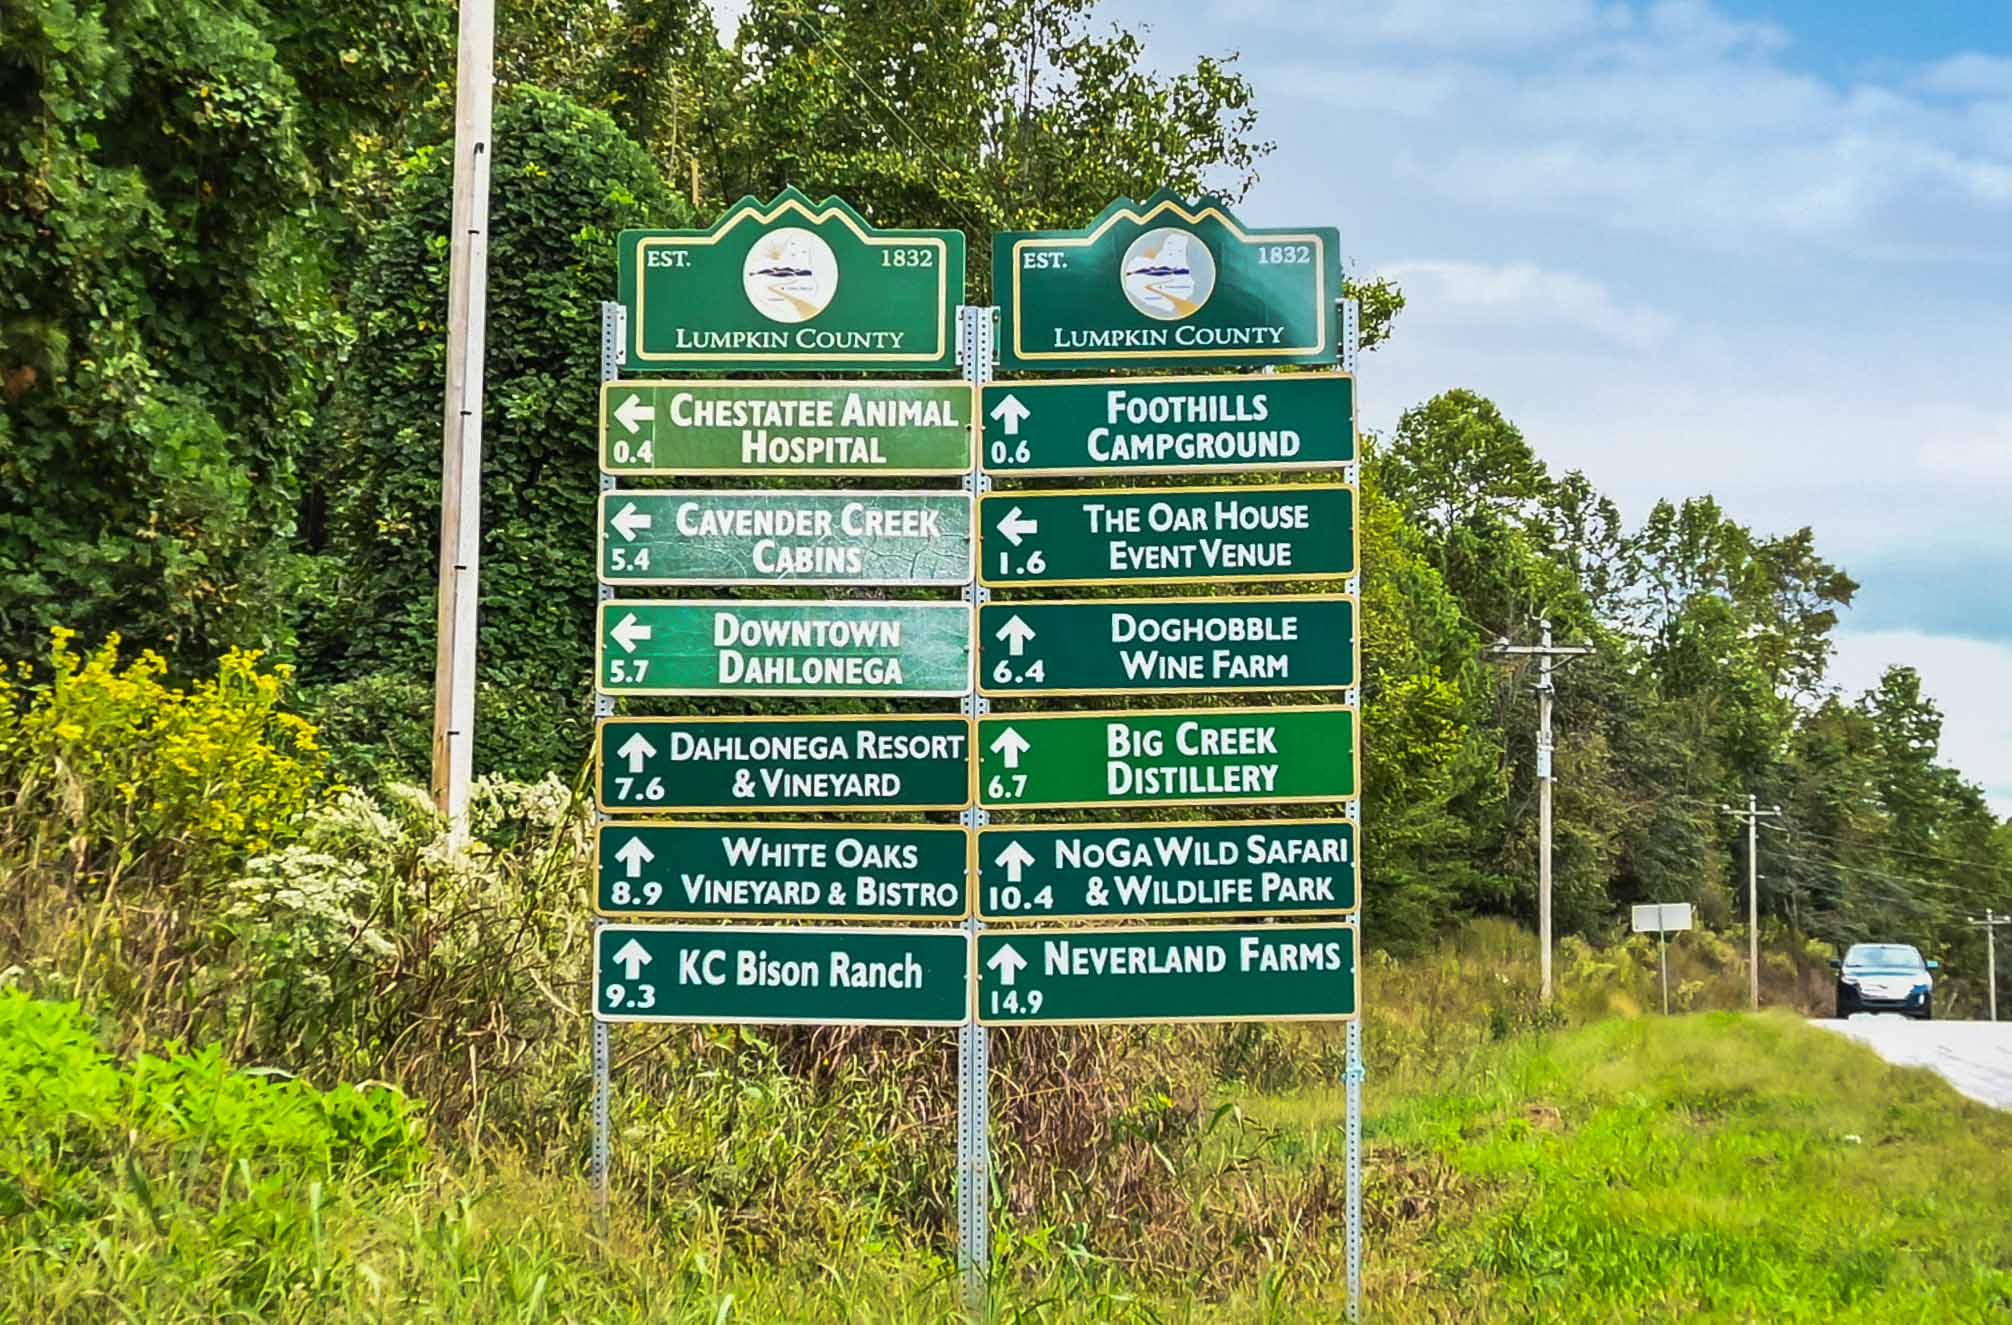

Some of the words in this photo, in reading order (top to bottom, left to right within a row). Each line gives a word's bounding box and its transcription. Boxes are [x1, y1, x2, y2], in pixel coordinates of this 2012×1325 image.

[648, 251, 691, 267] EST.
[881, 250, 932, 267] 1832
[1024, 253, 1067, 269] EST.
[1258, 247, 1310, 263] 1832
[676, 329, 788, 348] LUMPKIN
[796, 329, 904, 348] COUNTY
[1054, 328, 1167, 347] LUMPKIN
[1175, 326, 1284, 346] COUNTY
[670, 393, 833, 427] CHESTATEE
[841, 394, 959, 427] ANIMAL
[1108, 390, 1268, 424] FOOTHILLS
[613, 441, 653, 463] 0.4
[742, 430, 886, 463] HOSPITAL
[991, 441, 1030, 463] 0.6
[1088, 428, 1300, 461] CAMPGROUND
[676, 502, 832, 536] CAVENDER
[841, 503, 942, 537] CREEK
[1082, 504, 1140, 533] THE
[1148, 502, 1207, 532] OAR
[1215, 501, 1309, 529] HOUSE
[611, 549, 649, 571] 5.4
[752, 540, 861, 573] CABINS
[1000, 551, 1046, 574] 1.6
[1110, 542, 1196, 570] EVENT
[1199, 539, 1291, 568] VENUE
[714, 613, 900, 647] DOWNTOWN
[1112, 613, 1297, 642] DOGHOBBLE
[610, 660, 649, 683] 5.7
[719, 650, 903, 684] DAHLONEGA
[993, 659, 1045, 683] 6.4
[1120, 651, 1204, 680] WINE
[1213, 650, 1288, 679] FARM
[671, 732, 848, 761] DAHLONEGA
[857, 731, 964, 760] RESORT
[1108, 723, 1162, 758] BIG
[1176, 722, 1278, 756] CREEK
[615, 778, 665, 800] 7.6
[732, 769, 755, 798] &
[760, 768, 900, 798] VINEYARD
[988, 775, 1028, 798] 6.7
[1108, 761, 1279, 795] DISTILLERY
[722, 837, 826, 867] WHITE
[835, 838, 918, 868] OAKS
[1153, 836, 1238, 867] WILD
[1248, 835, 1348, 864] SAFARI
[611, 882, 662, 905] 8.9
[681, 874, 820, 904] VINEYARD
[828, 882, 846, 906] &
[857, 877, 958, 907] BISTRO
[989, 886, 1053, 910] 10.4
[1086, 876, 1108, 906] &
[1113, 875, 1252, 905] WILDLIFE
[1262, 872, 1334, 902] PARK
[679, 949, 726, 985] KC
[737, 950, 818, 986] Bison
[830, 952, 922, 988] Ranch
[1044, 941, 1226, 976] NEVERLAND
[1240, 937, 1340, 972] FARMS
[606, 985, 656, 1008] 9.3
[991, 990, 1043, 1014] 14.9
